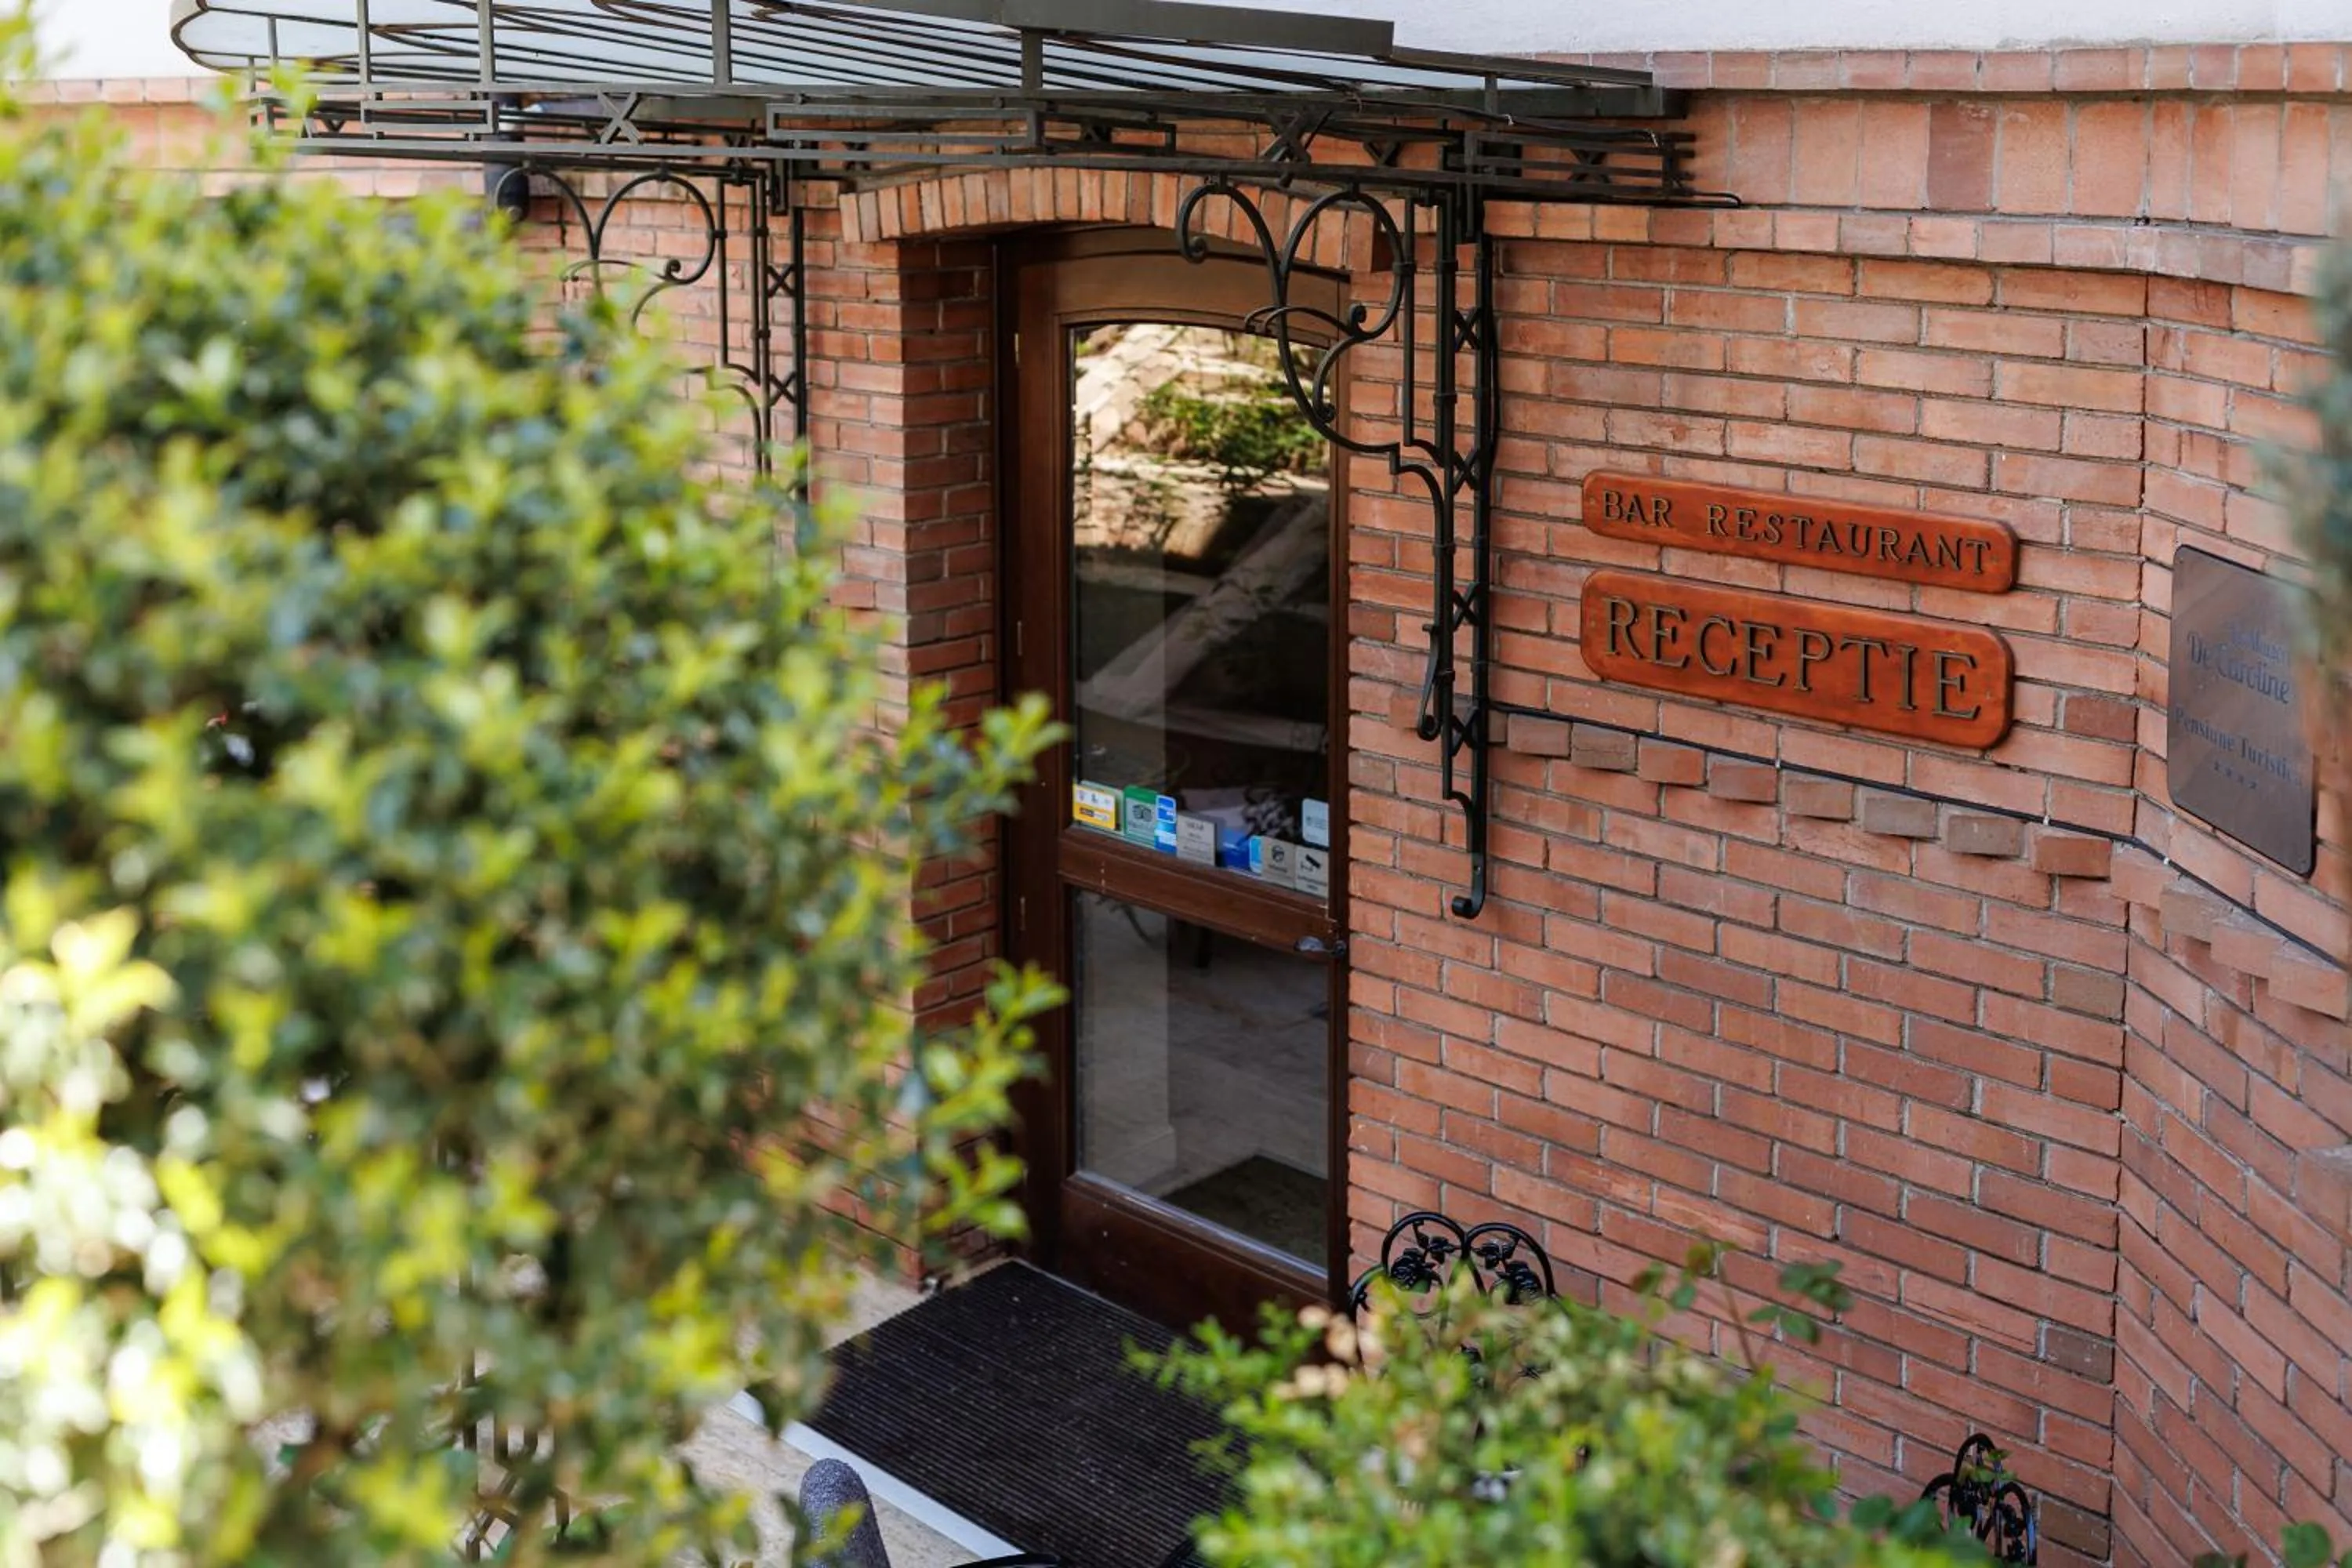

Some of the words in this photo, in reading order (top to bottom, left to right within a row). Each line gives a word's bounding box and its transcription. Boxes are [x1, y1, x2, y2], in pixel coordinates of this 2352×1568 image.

[1603, 491, 1671, 528] BAR
[1705, 504, 1991, 574] RESTAURANT
[1602, 597, 1982, 720] RECEPTIE
